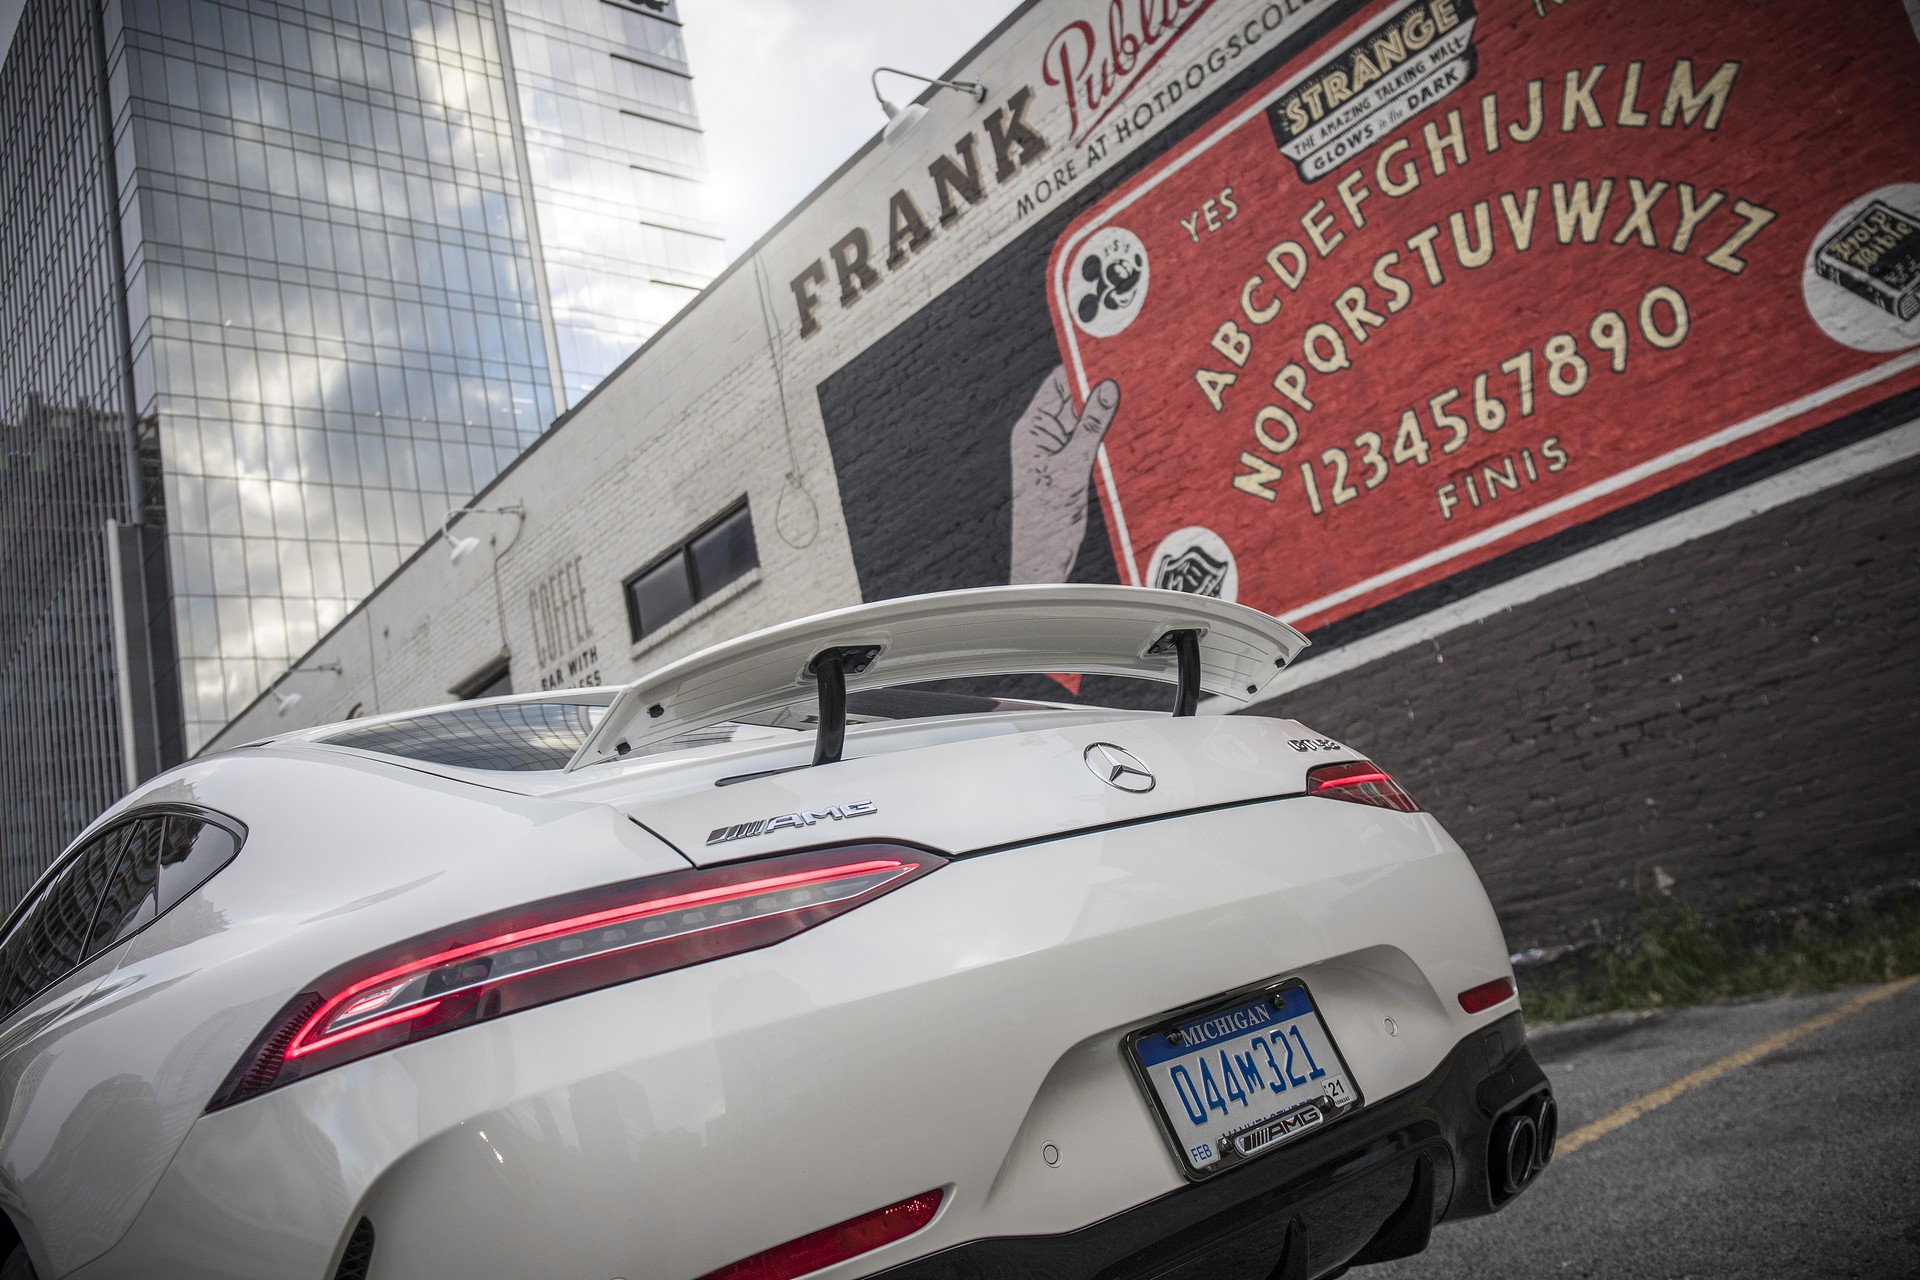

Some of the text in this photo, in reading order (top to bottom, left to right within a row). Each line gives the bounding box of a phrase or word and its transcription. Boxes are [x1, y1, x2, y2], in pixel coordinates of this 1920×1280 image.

[1286, 0, 1459, 135] STRANGE
[1294, 136, 1316, 154] THE
[1320, 99, 1371, 140] AMAZING
[1375, 60, 1426, 101] TALKING
[1017, 0, 1312, 220] MORE AT HOTDOGSCOL
[1314, 68, 1460, 169] GLOWS in the DARK
[789, 84, 1051, 339] FRANK
[1179, 187, 1238, 243] YES
[1436, 437, 1569, 519] FINIS
[529, 556, 592, 669] COFFEE
[541, 669, 564, 691] BAR
[568, 645, 599, 677] WITH
[764, 800, 877, 834] AMG
[1181, 1003, 1271, 1047] MICHIGAN
[1170, 1024, 1326, 1126] 044M321
[1327, 1079, 1345, 1097] 21
[1191, 1143, 1212, 1163] FEB
[1268, 1107, 1320, 1140] AMG
